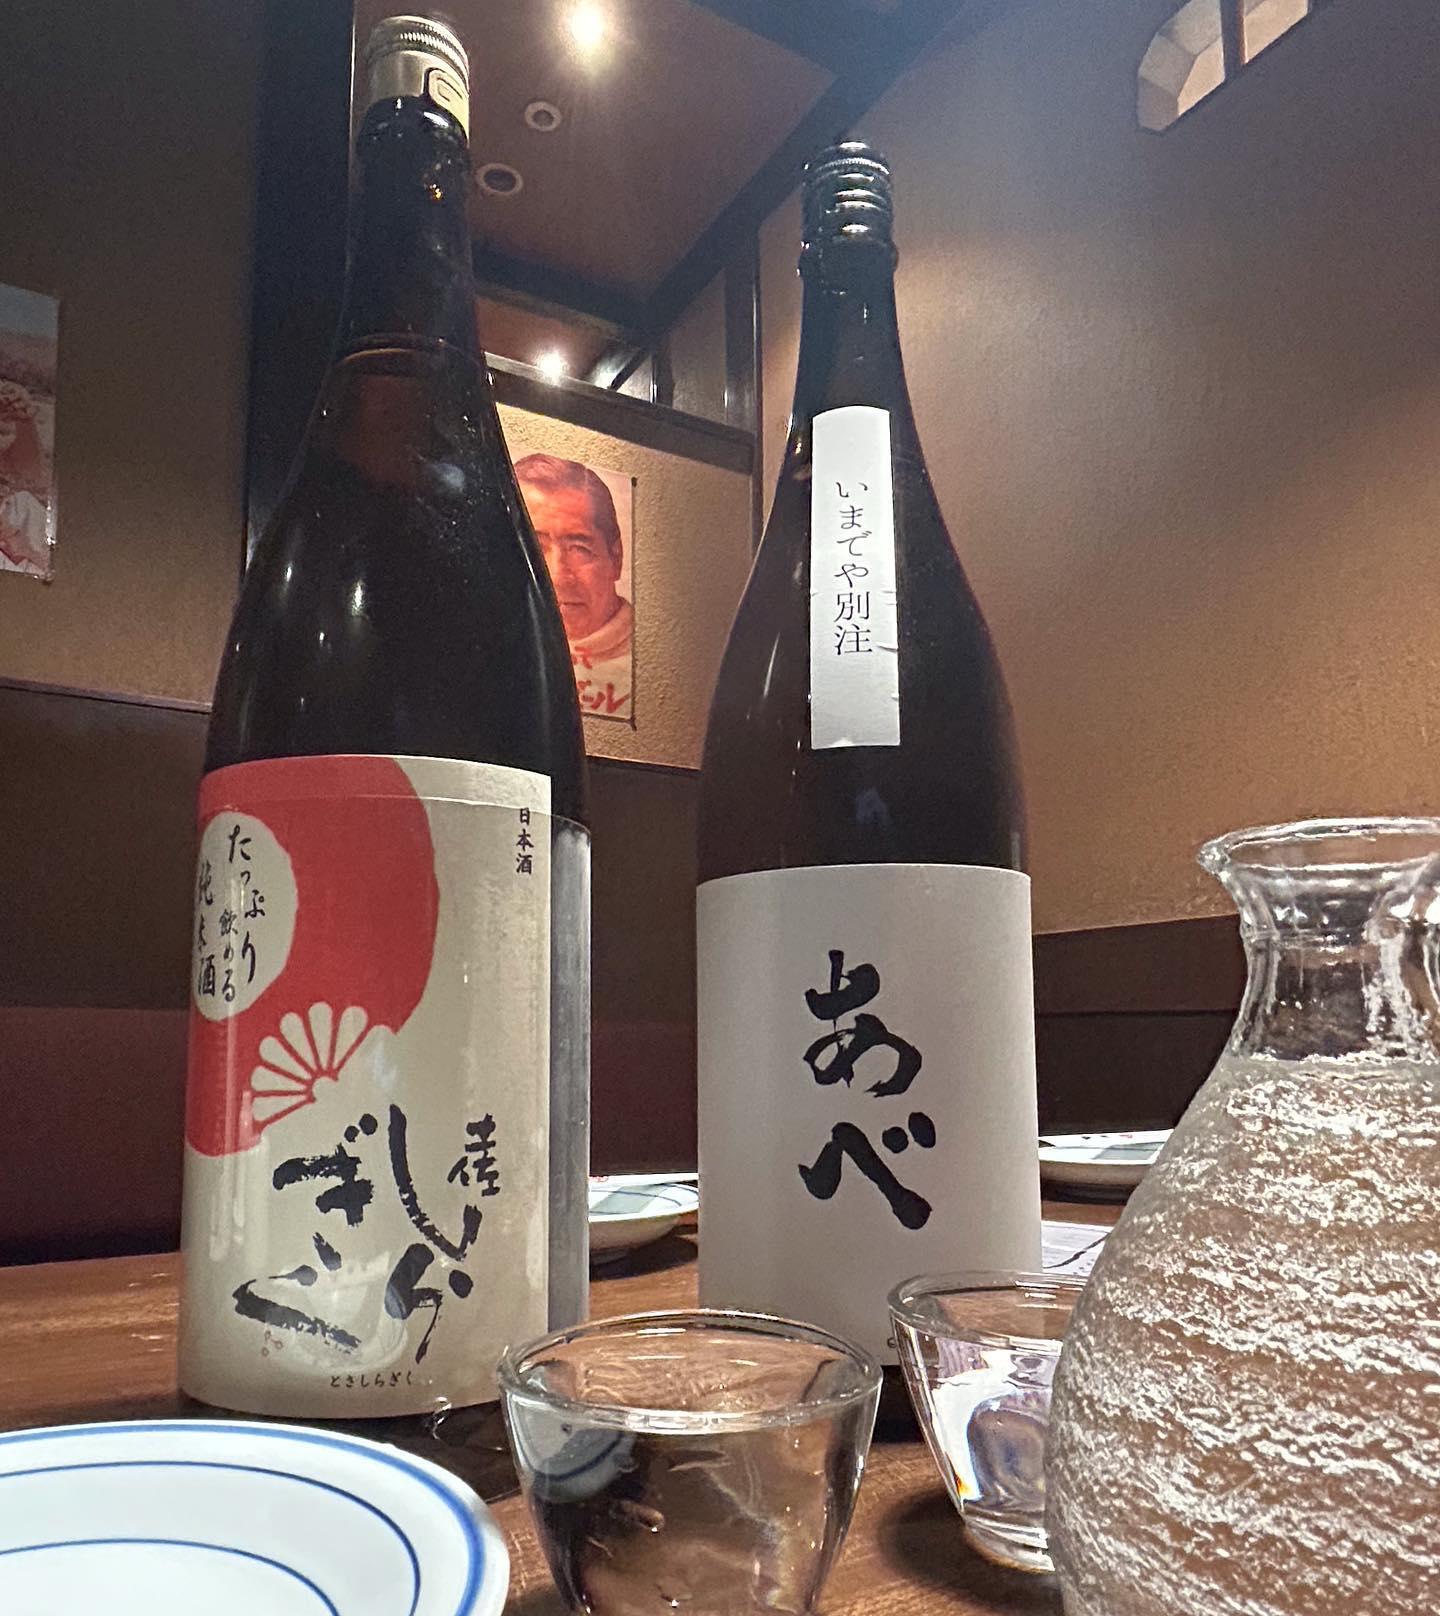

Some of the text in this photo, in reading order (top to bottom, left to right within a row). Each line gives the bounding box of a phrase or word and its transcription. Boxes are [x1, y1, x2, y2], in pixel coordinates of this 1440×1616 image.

[834, 481, 873, 655] いまでや別注
[516, 807, 535, 875] 日本酒
[228, 824, 265, 983] たっぷり
[219, 908, 238, 1002] 飲める
[798, 949, 936, 1230] あべ
[447, 1112, 501, 1197] 土佐
[330, 1369, 413, 1389] とさしらぎく
